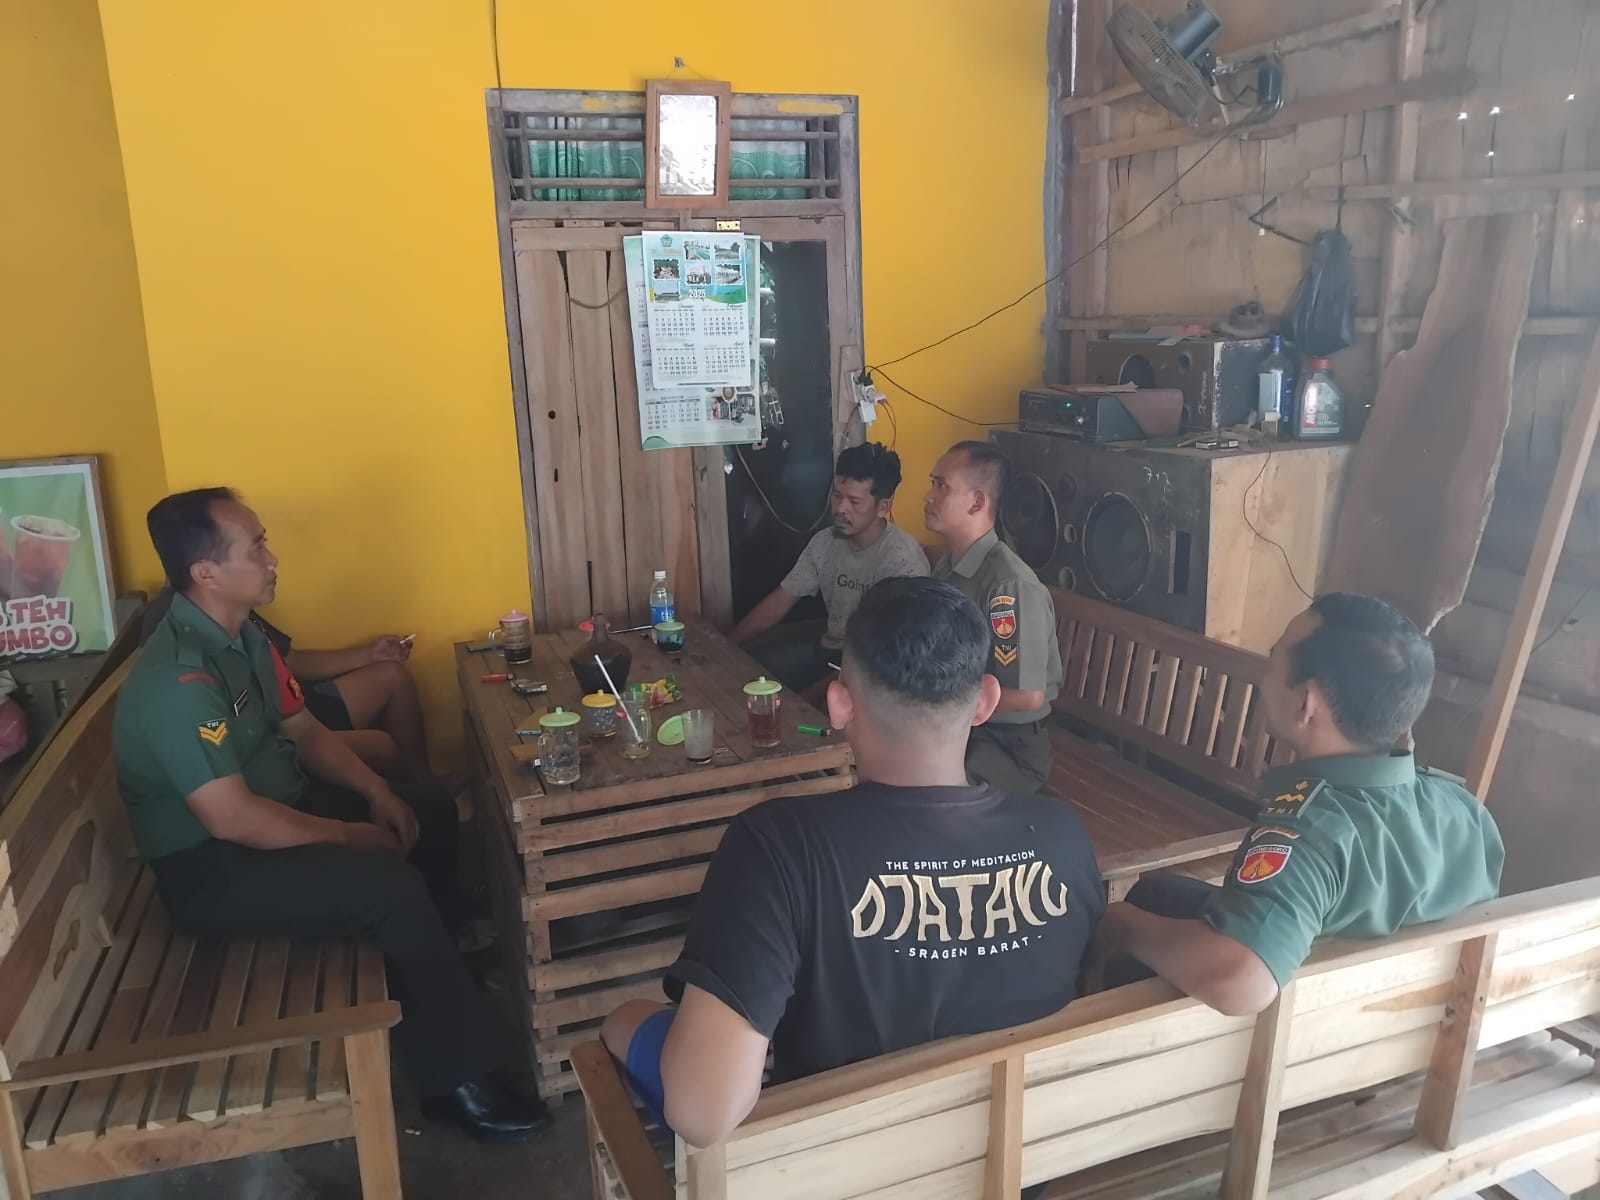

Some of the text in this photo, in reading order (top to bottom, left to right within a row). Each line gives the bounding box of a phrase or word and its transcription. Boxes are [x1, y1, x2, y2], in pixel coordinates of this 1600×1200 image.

[688, 288, 706, 298] 2025
[10, 600, 67, 625] TEH
[886, 849, 1035, 870] THE SPIRIT OF MEDITACION
[908, 947, 968, 960] SRAGEN
[977, 936, 1029, 956] BARAT
